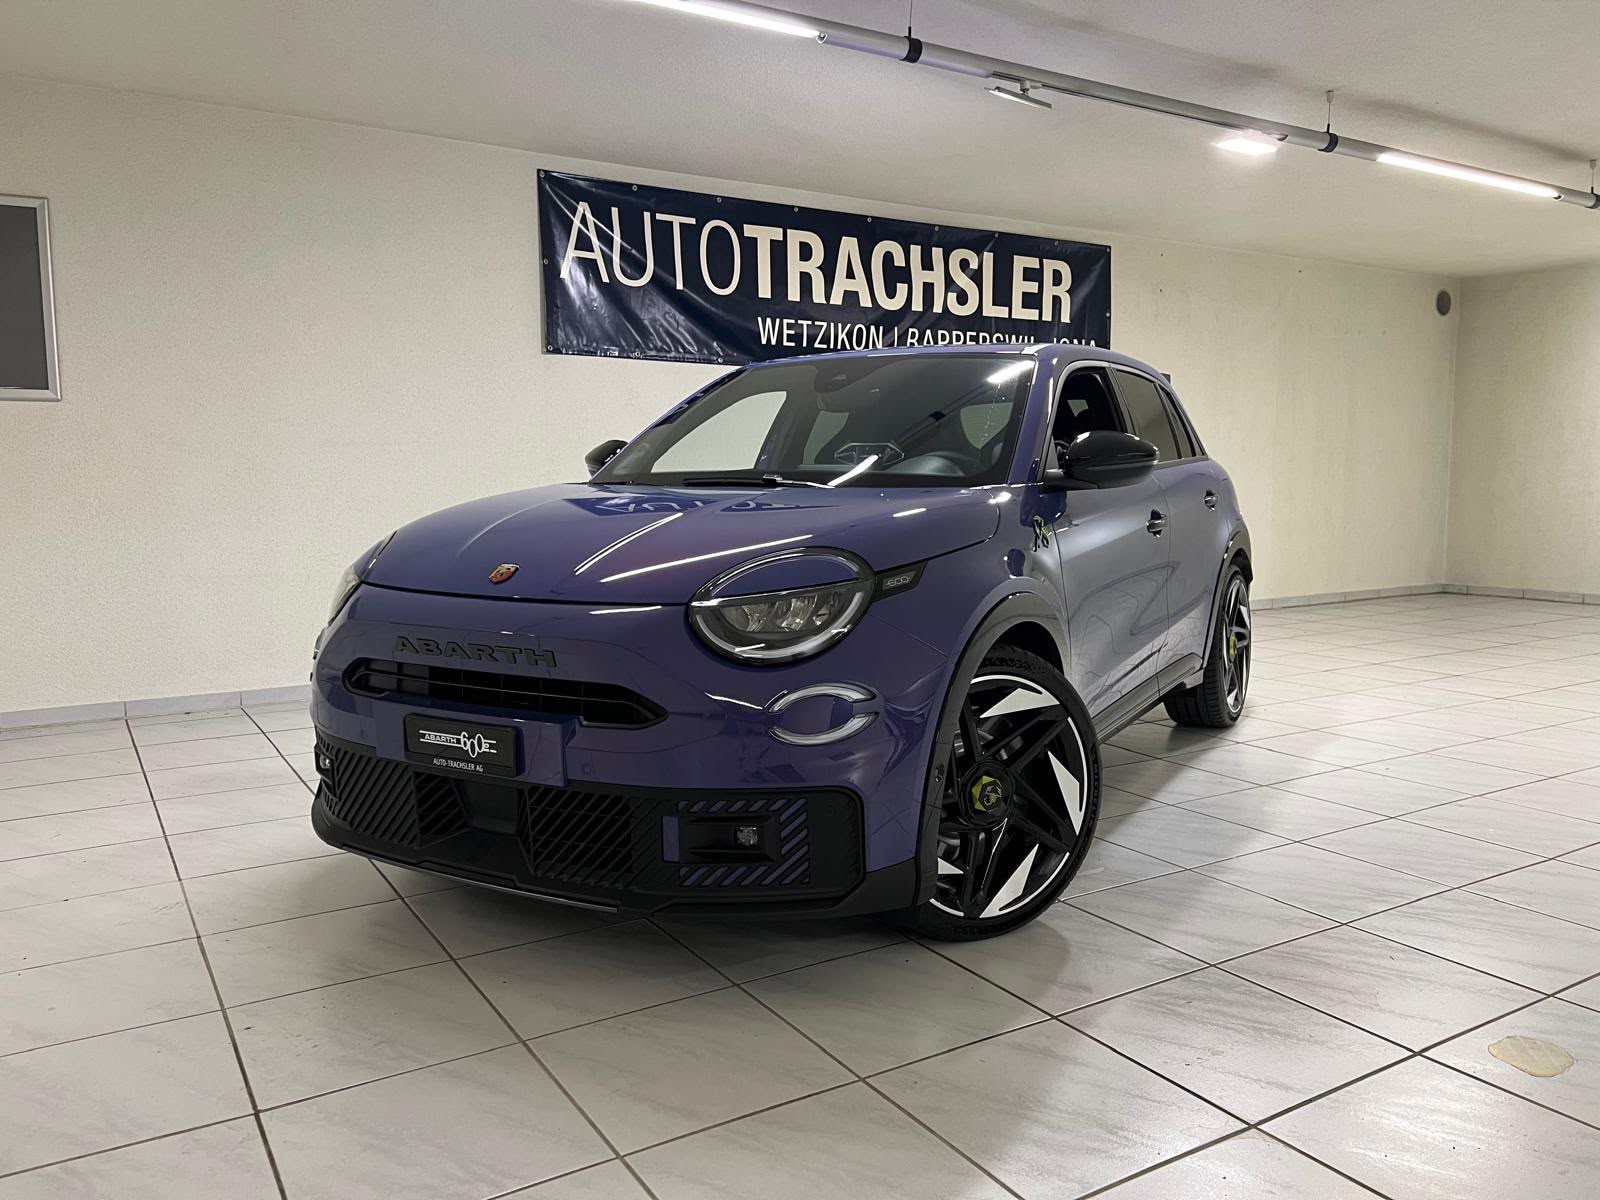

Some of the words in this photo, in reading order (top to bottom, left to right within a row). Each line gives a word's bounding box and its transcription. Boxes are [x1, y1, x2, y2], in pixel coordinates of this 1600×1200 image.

[757, 316, 883, 351] WETZIKON
[395, 636, 557, 668] ABARTH
[424, 734, 457, 744] ABARTH
[433, 758, 475, 771] AUTO-TRACHSLER
[475, 764, 484, 772] AG
